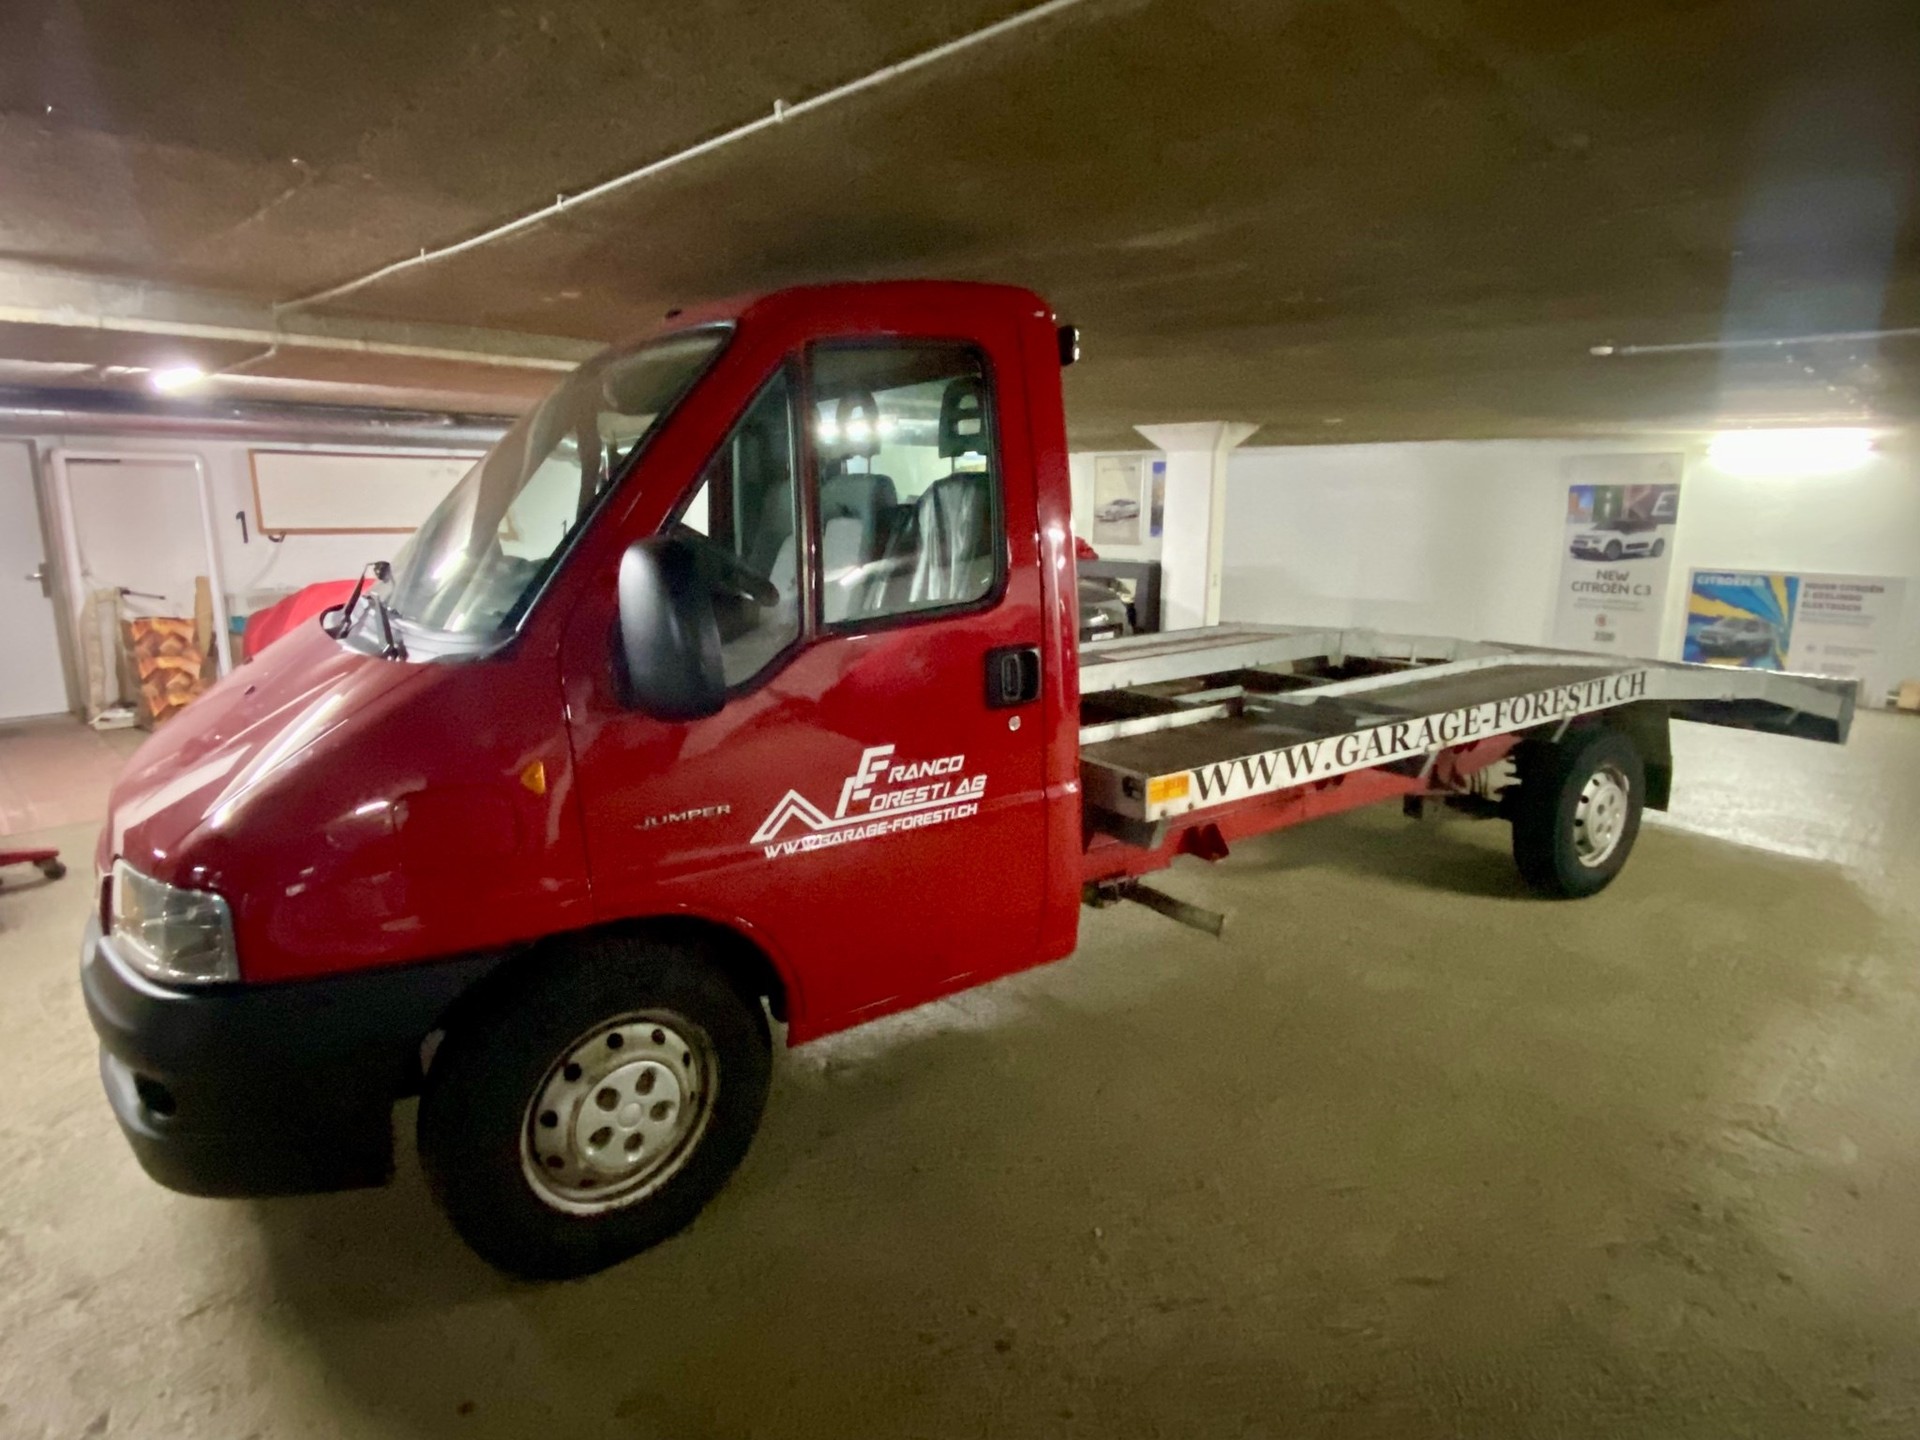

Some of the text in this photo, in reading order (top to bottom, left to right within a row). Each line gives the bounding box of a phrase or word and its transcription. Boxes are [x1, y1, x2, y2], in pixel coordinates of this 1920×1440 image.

[1596, 569, 1630, 581] NEW
[1633, 583, 1652, 596] C3
[1190, 670, 1647, 801] WWW.GARAGE-FORESTI.CH
[854, 744, 965, 789] FRANCO
[835, 774, 987, 819] FORESTI AG
[635, 804, 731, 830] JUMPER
